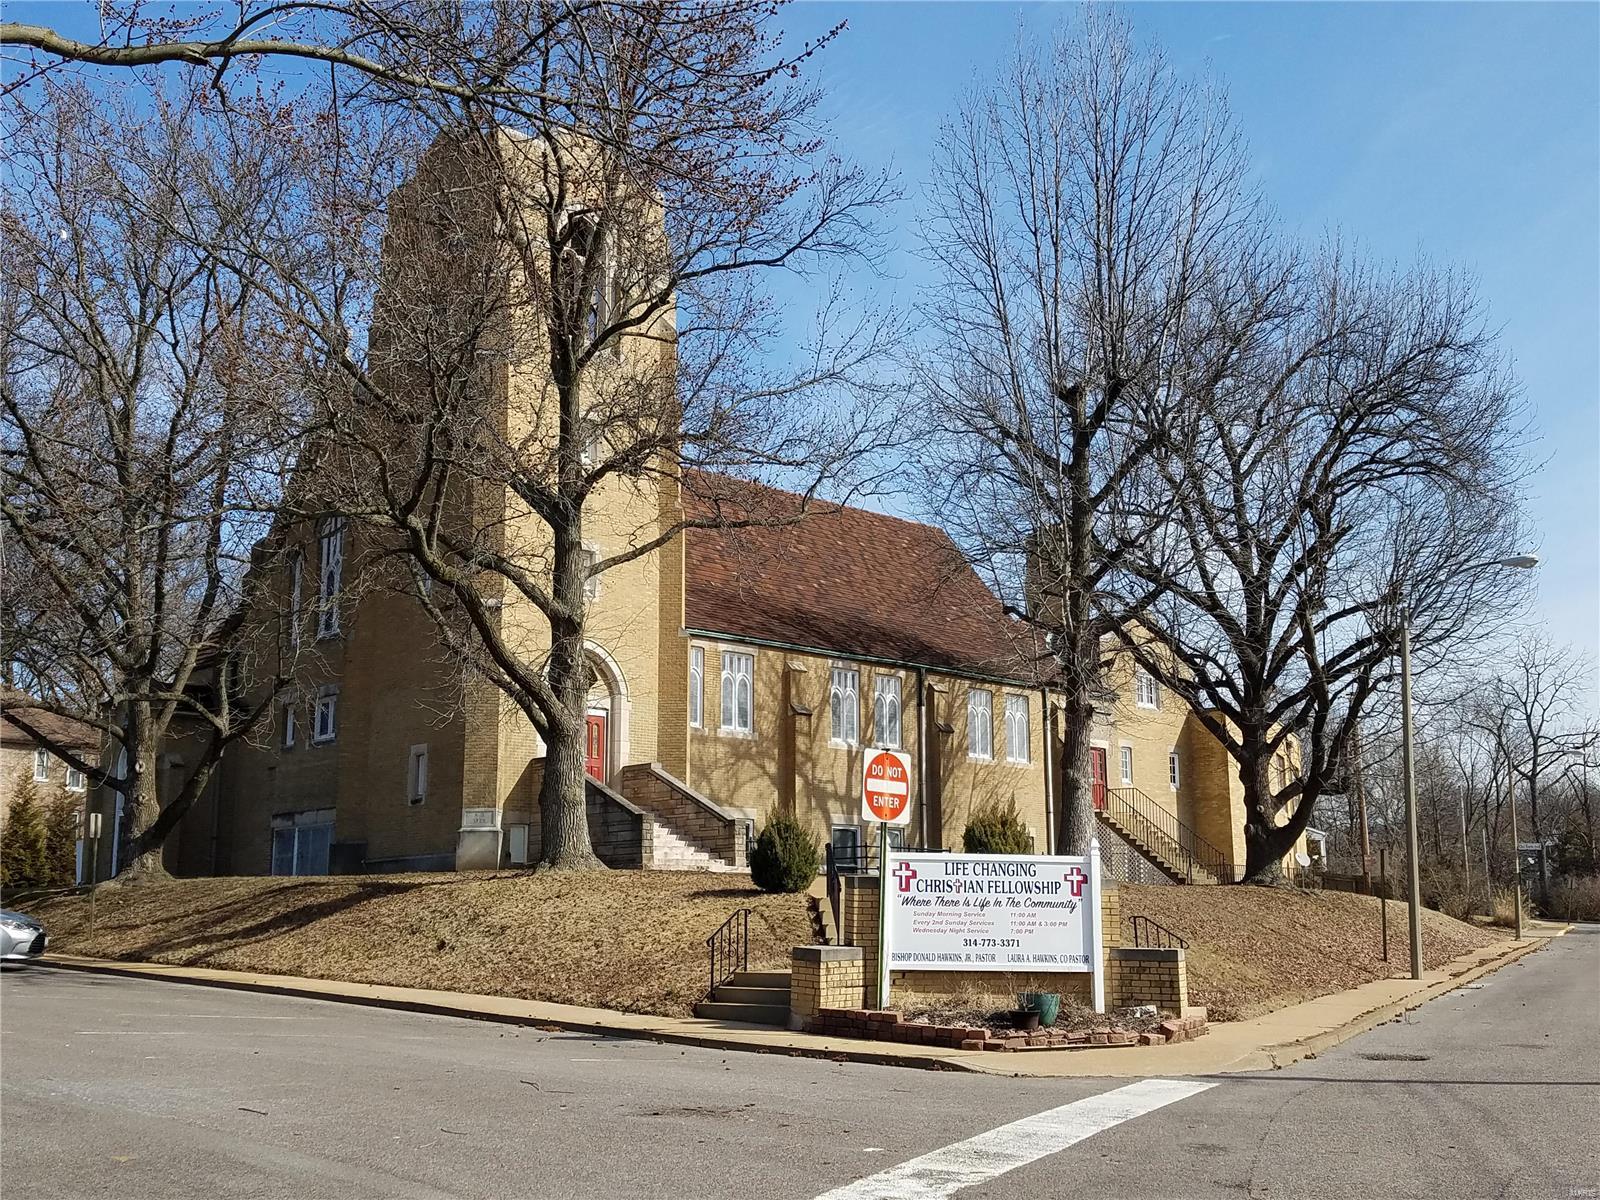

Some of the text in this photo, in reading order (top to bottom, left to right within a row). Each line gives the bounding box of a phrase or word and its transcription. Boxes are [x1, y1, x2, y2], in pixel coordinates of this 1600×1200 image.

[872, 764, 902, 778] DO NOT
[873, 796, 900, 808] ENTER
[944, 862, 1036, 877] LIFE CHANGING
[988, 880, 1062, 894] FELLOWSHIP
[934, 896, 960, 907] There
[962, 896, 971, 907] Is
[973, 897, 990, 912] Life
[993, 897, 1002, 907] In
[1006, 897, 1022, 908] The
[963, 938, 1020, 947] 314-773-3371
[892, 952, 912, 962] BISHOP
[913, 953, 935, 962] DONALD
[937, 953, 963, 963] HAWKINS,
[976, 954, 996, 962] PASTOR
[1007, 954, 1024, 963] LAURA
[1060, 955, 1068, 963] CO
[1069, 955, 1090, 964] PASTOR
